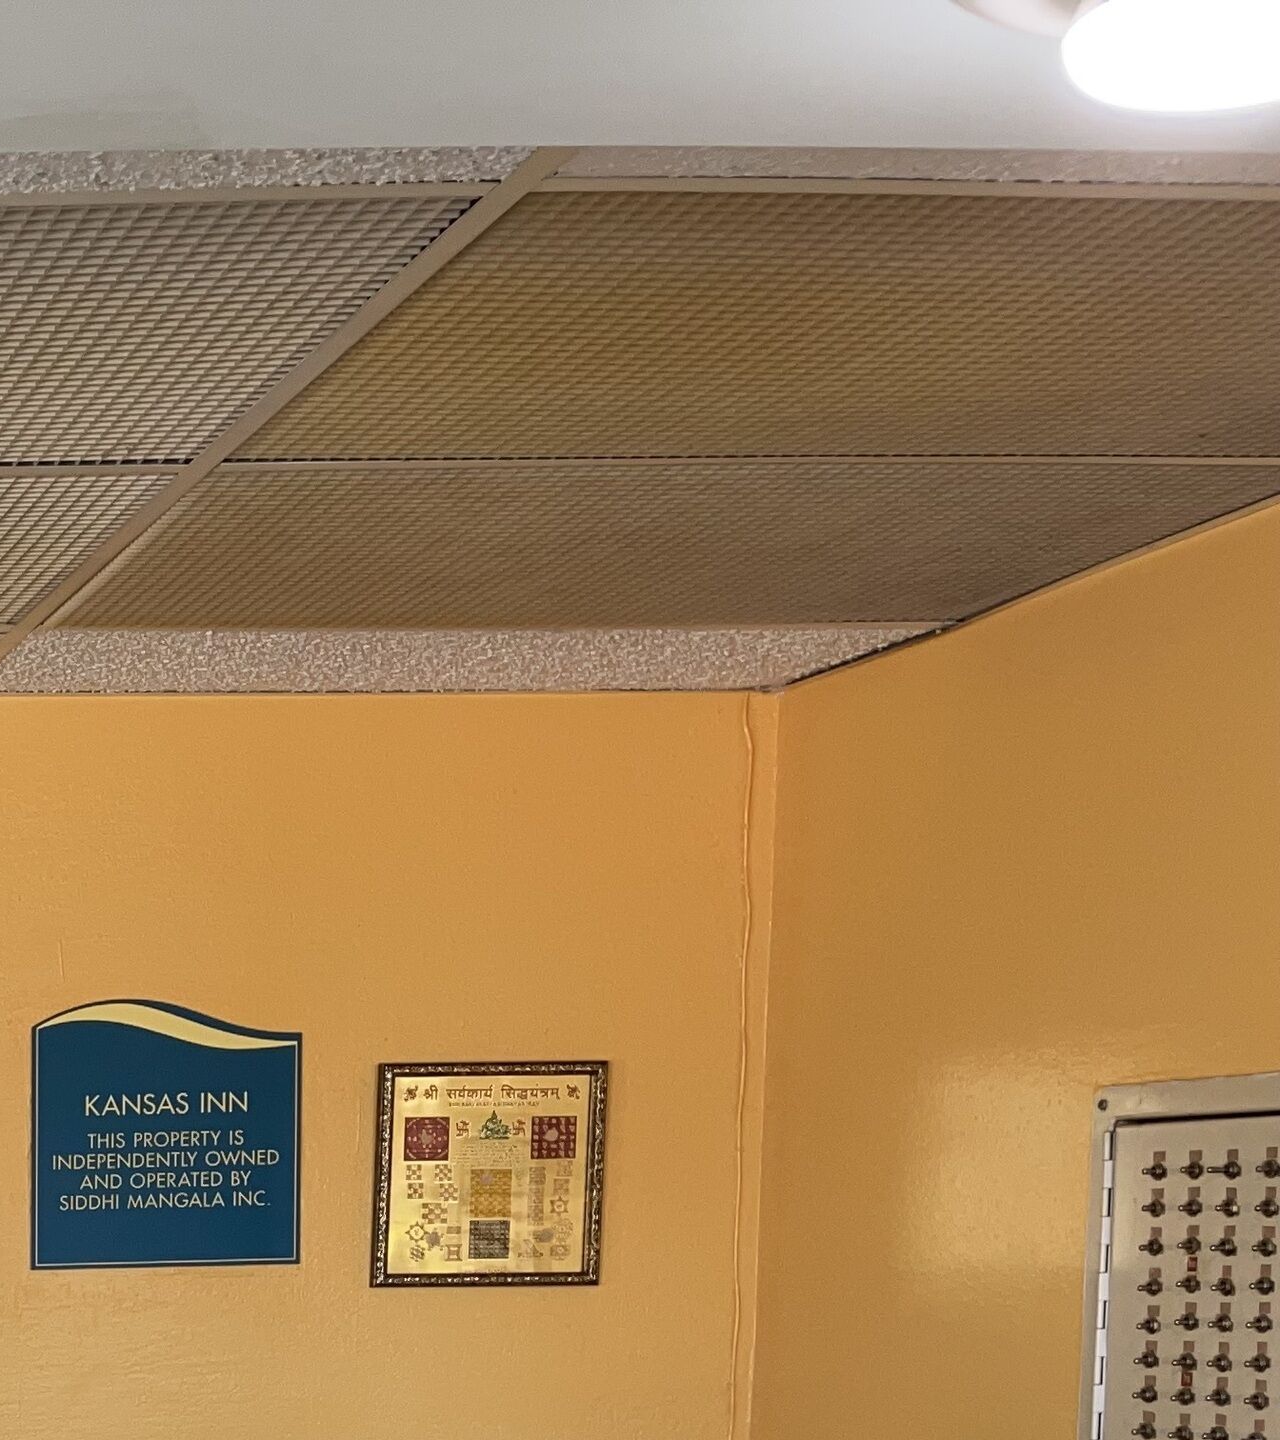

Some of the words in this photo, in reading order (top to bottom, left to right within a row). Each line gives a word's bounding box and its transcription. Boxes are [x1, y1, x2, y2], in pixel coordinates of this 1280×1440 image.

[423, 1084, 438, 1100] श्री
[84, 1093, 190, 1117] KANSAS
[200, 1092, 249, 1114] INN
[87, 1132, 127, 1148] THIS
[133, 1130, 221, 1148] PROPERTY
[228, 1130, 244, 1146] IS
[52, 1151, 197, 1170] INDEPENDENTLY
[205, 1149, 280, 1167] OWNED
[79, 1172, 122, 1189] AND
[130, 1170, 224, 1189] OPERATED
[230, 1169, 252, 1186] BY
[59, 1192, 120, 1210] SIDDHI
[126, 1190, 225, 1210] MANGALA
[232, 1189, 272, 1208] INC.
